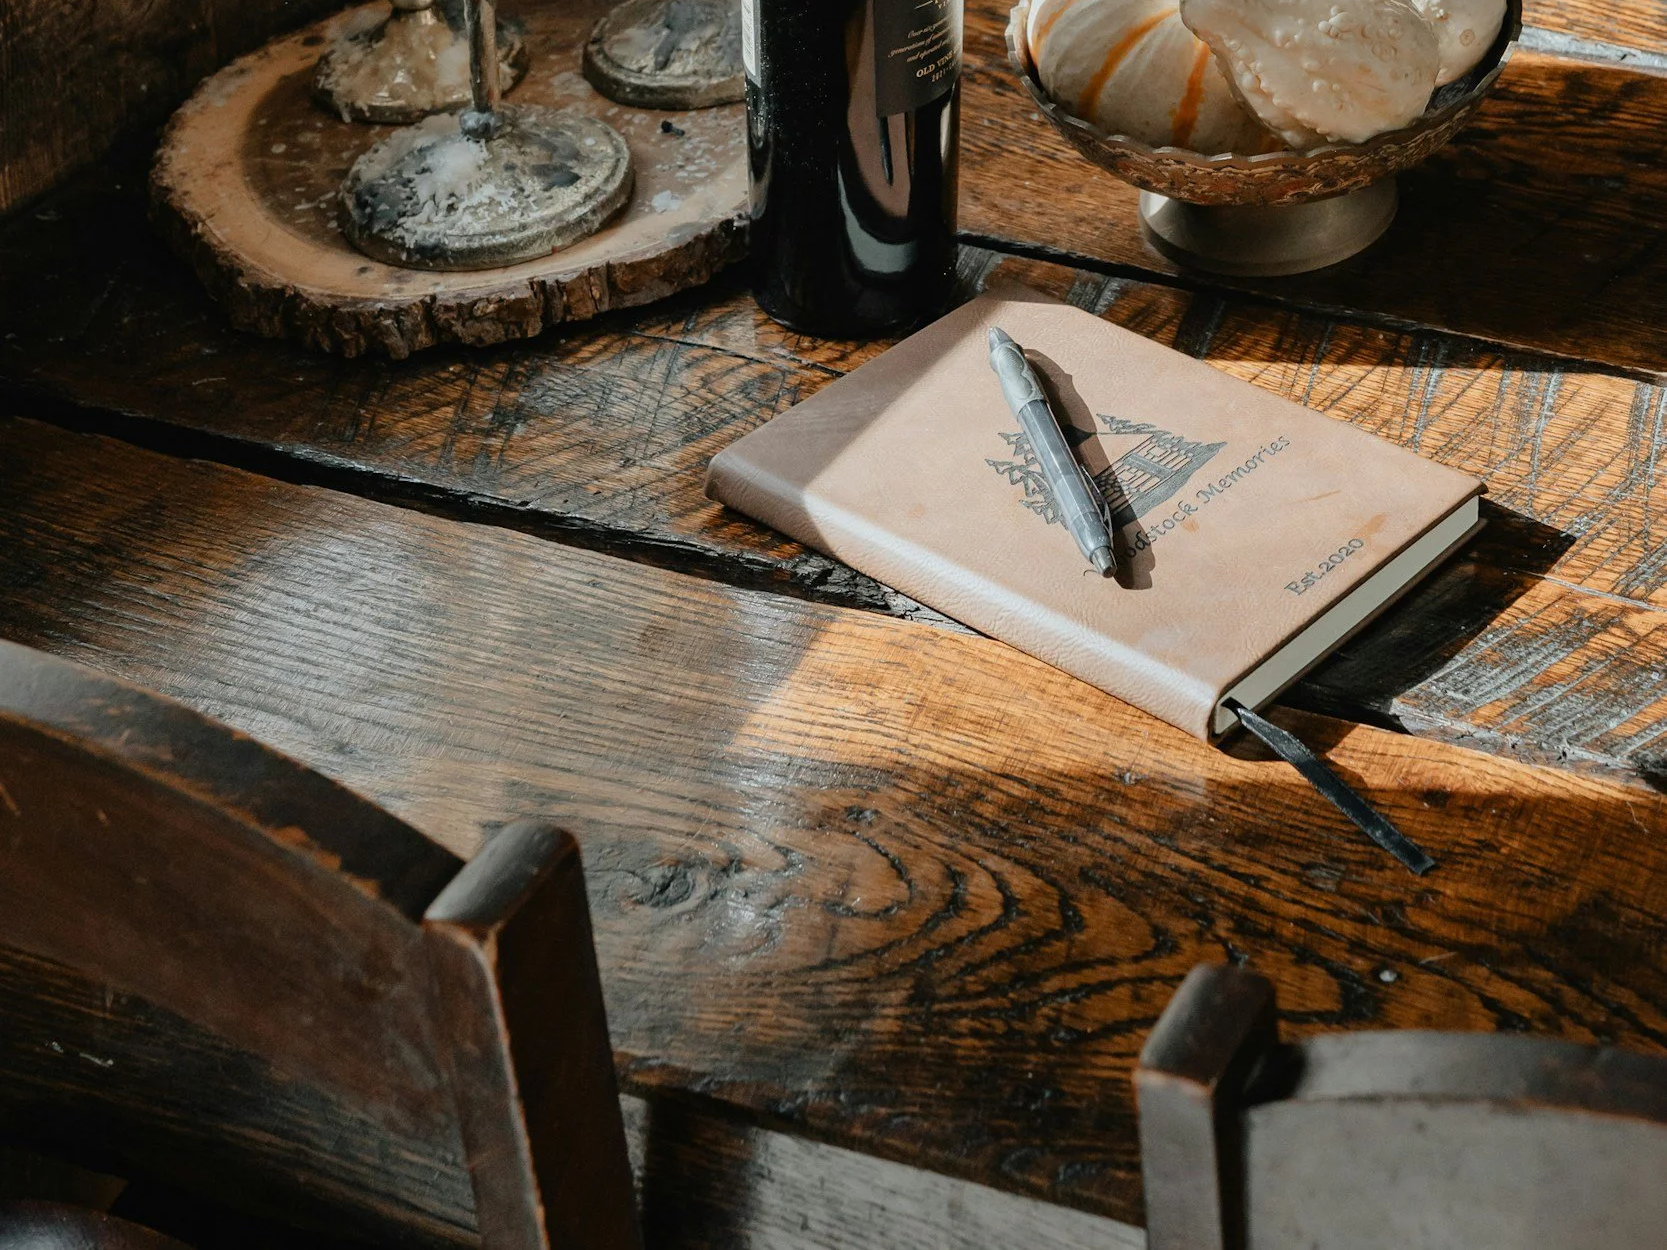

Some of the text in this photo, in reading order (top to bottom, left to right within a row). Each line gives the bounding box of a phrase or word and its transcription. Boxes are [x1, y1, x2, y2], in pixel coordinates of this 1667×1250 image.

[916, 64, 935, 78] OLD
[1196, 435, 1291, 504] Memories
[1284, 538, 1364, 596] Est.2020
